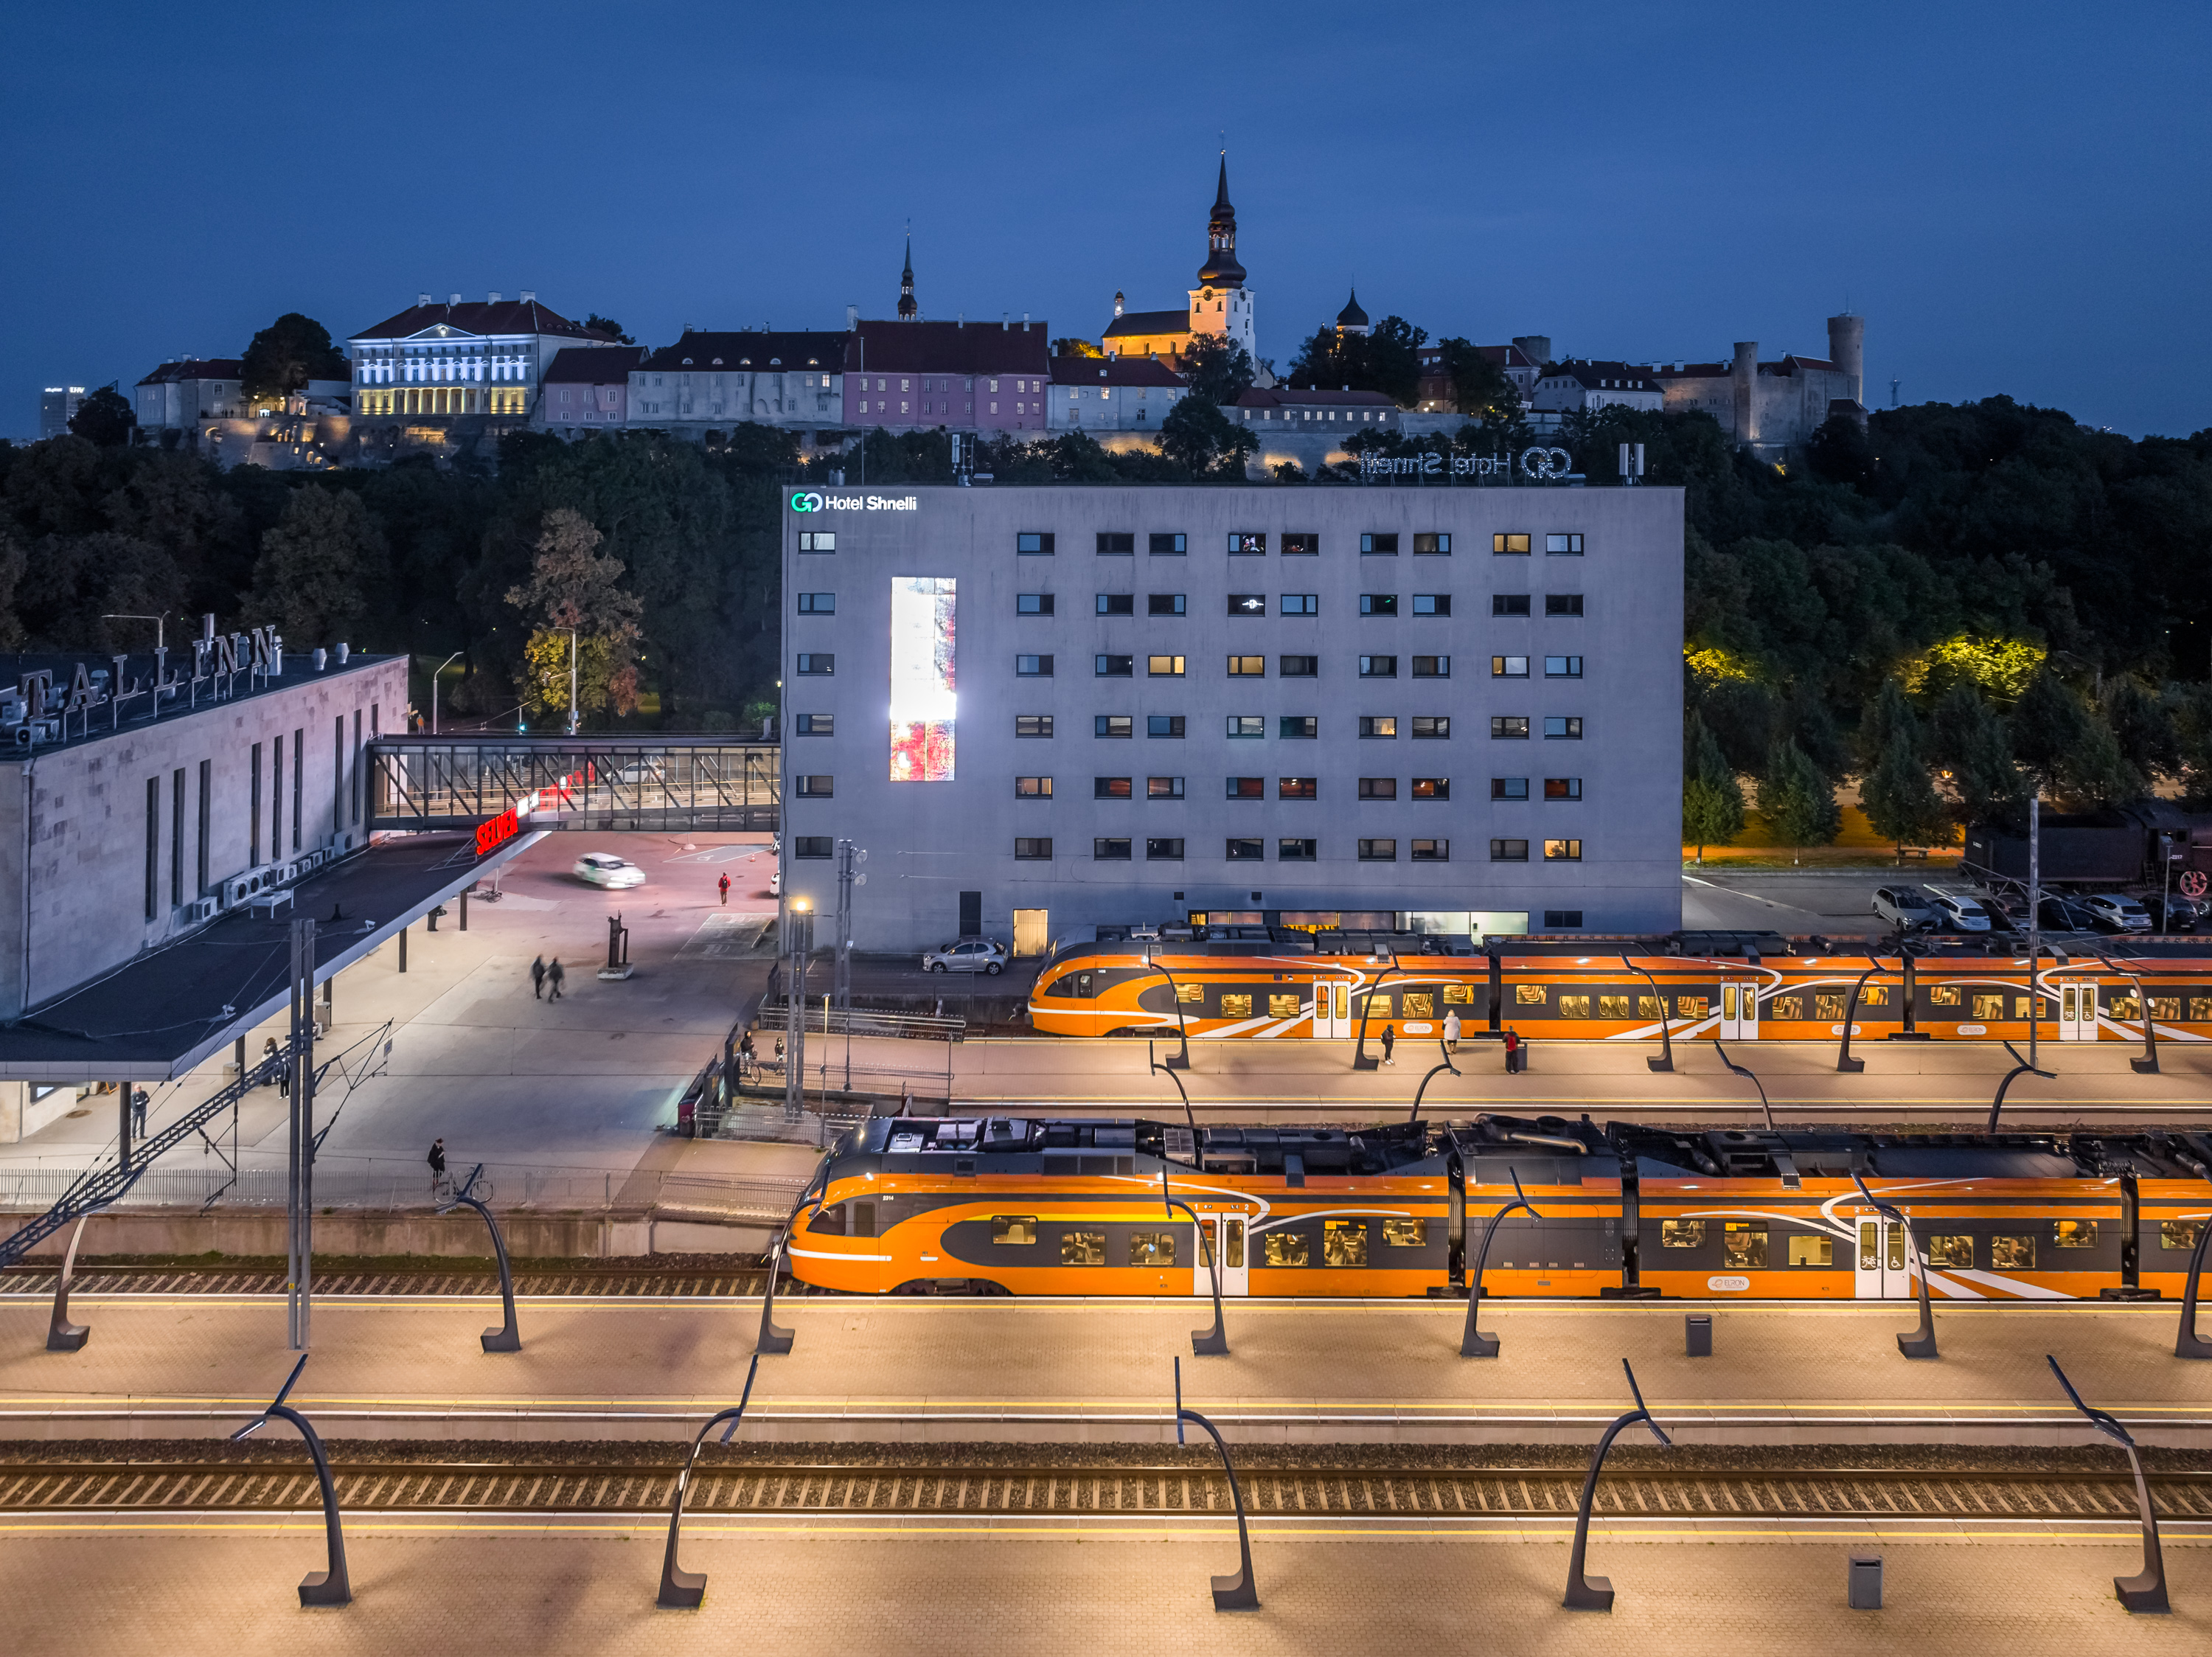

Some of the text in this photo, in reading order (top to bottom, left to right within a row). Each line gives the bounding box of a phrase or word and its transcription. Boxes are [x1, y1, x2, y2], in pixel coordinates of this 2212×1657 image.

[825, 496, 863, 510] Hotel
[866, 496, 917, 510] Shnelli
[17, 625, 276, 721] TALLINN
[476, 806, 518, 855] SELVER
[1194, 1203, 1198, 1211] 1
